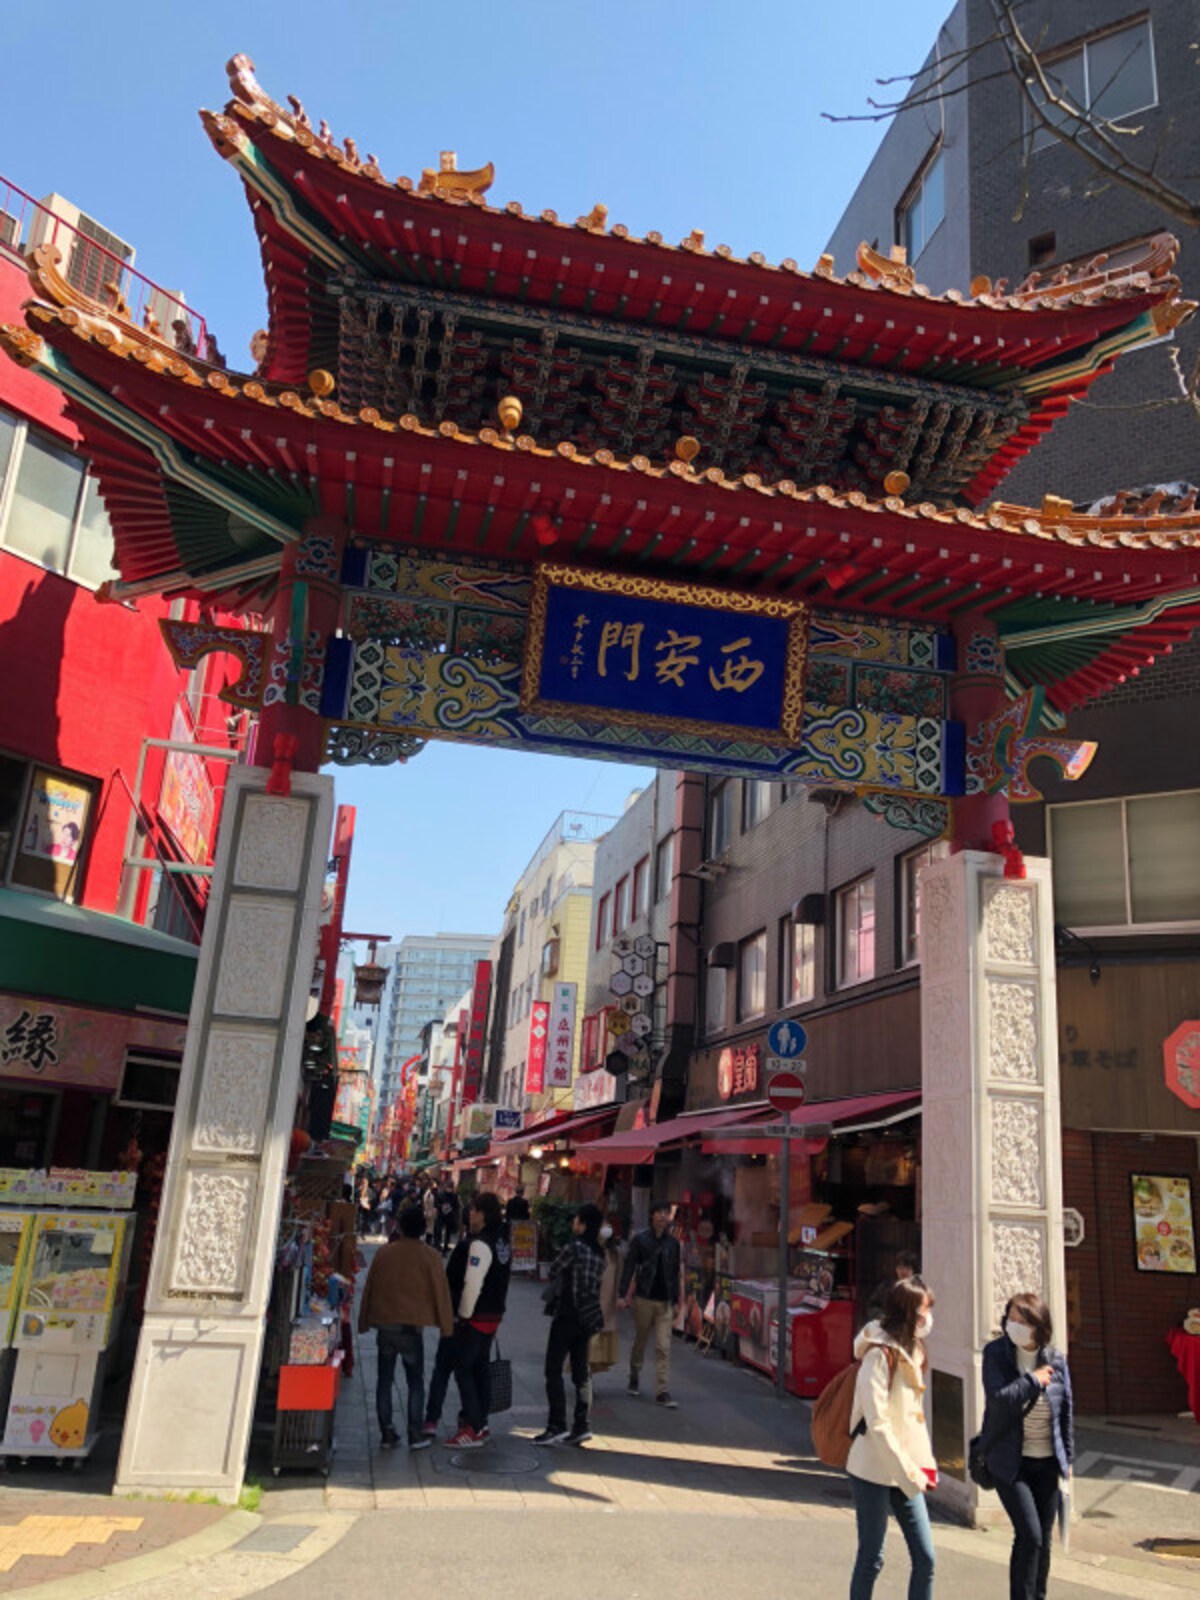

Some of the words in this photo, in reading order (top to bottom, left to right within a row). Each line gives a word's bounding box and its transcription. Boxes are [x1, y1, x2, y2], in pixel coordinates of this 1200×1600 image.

[597, 621, 765, 693] 西安門
[2, 1010, 57, 1070] 縁
